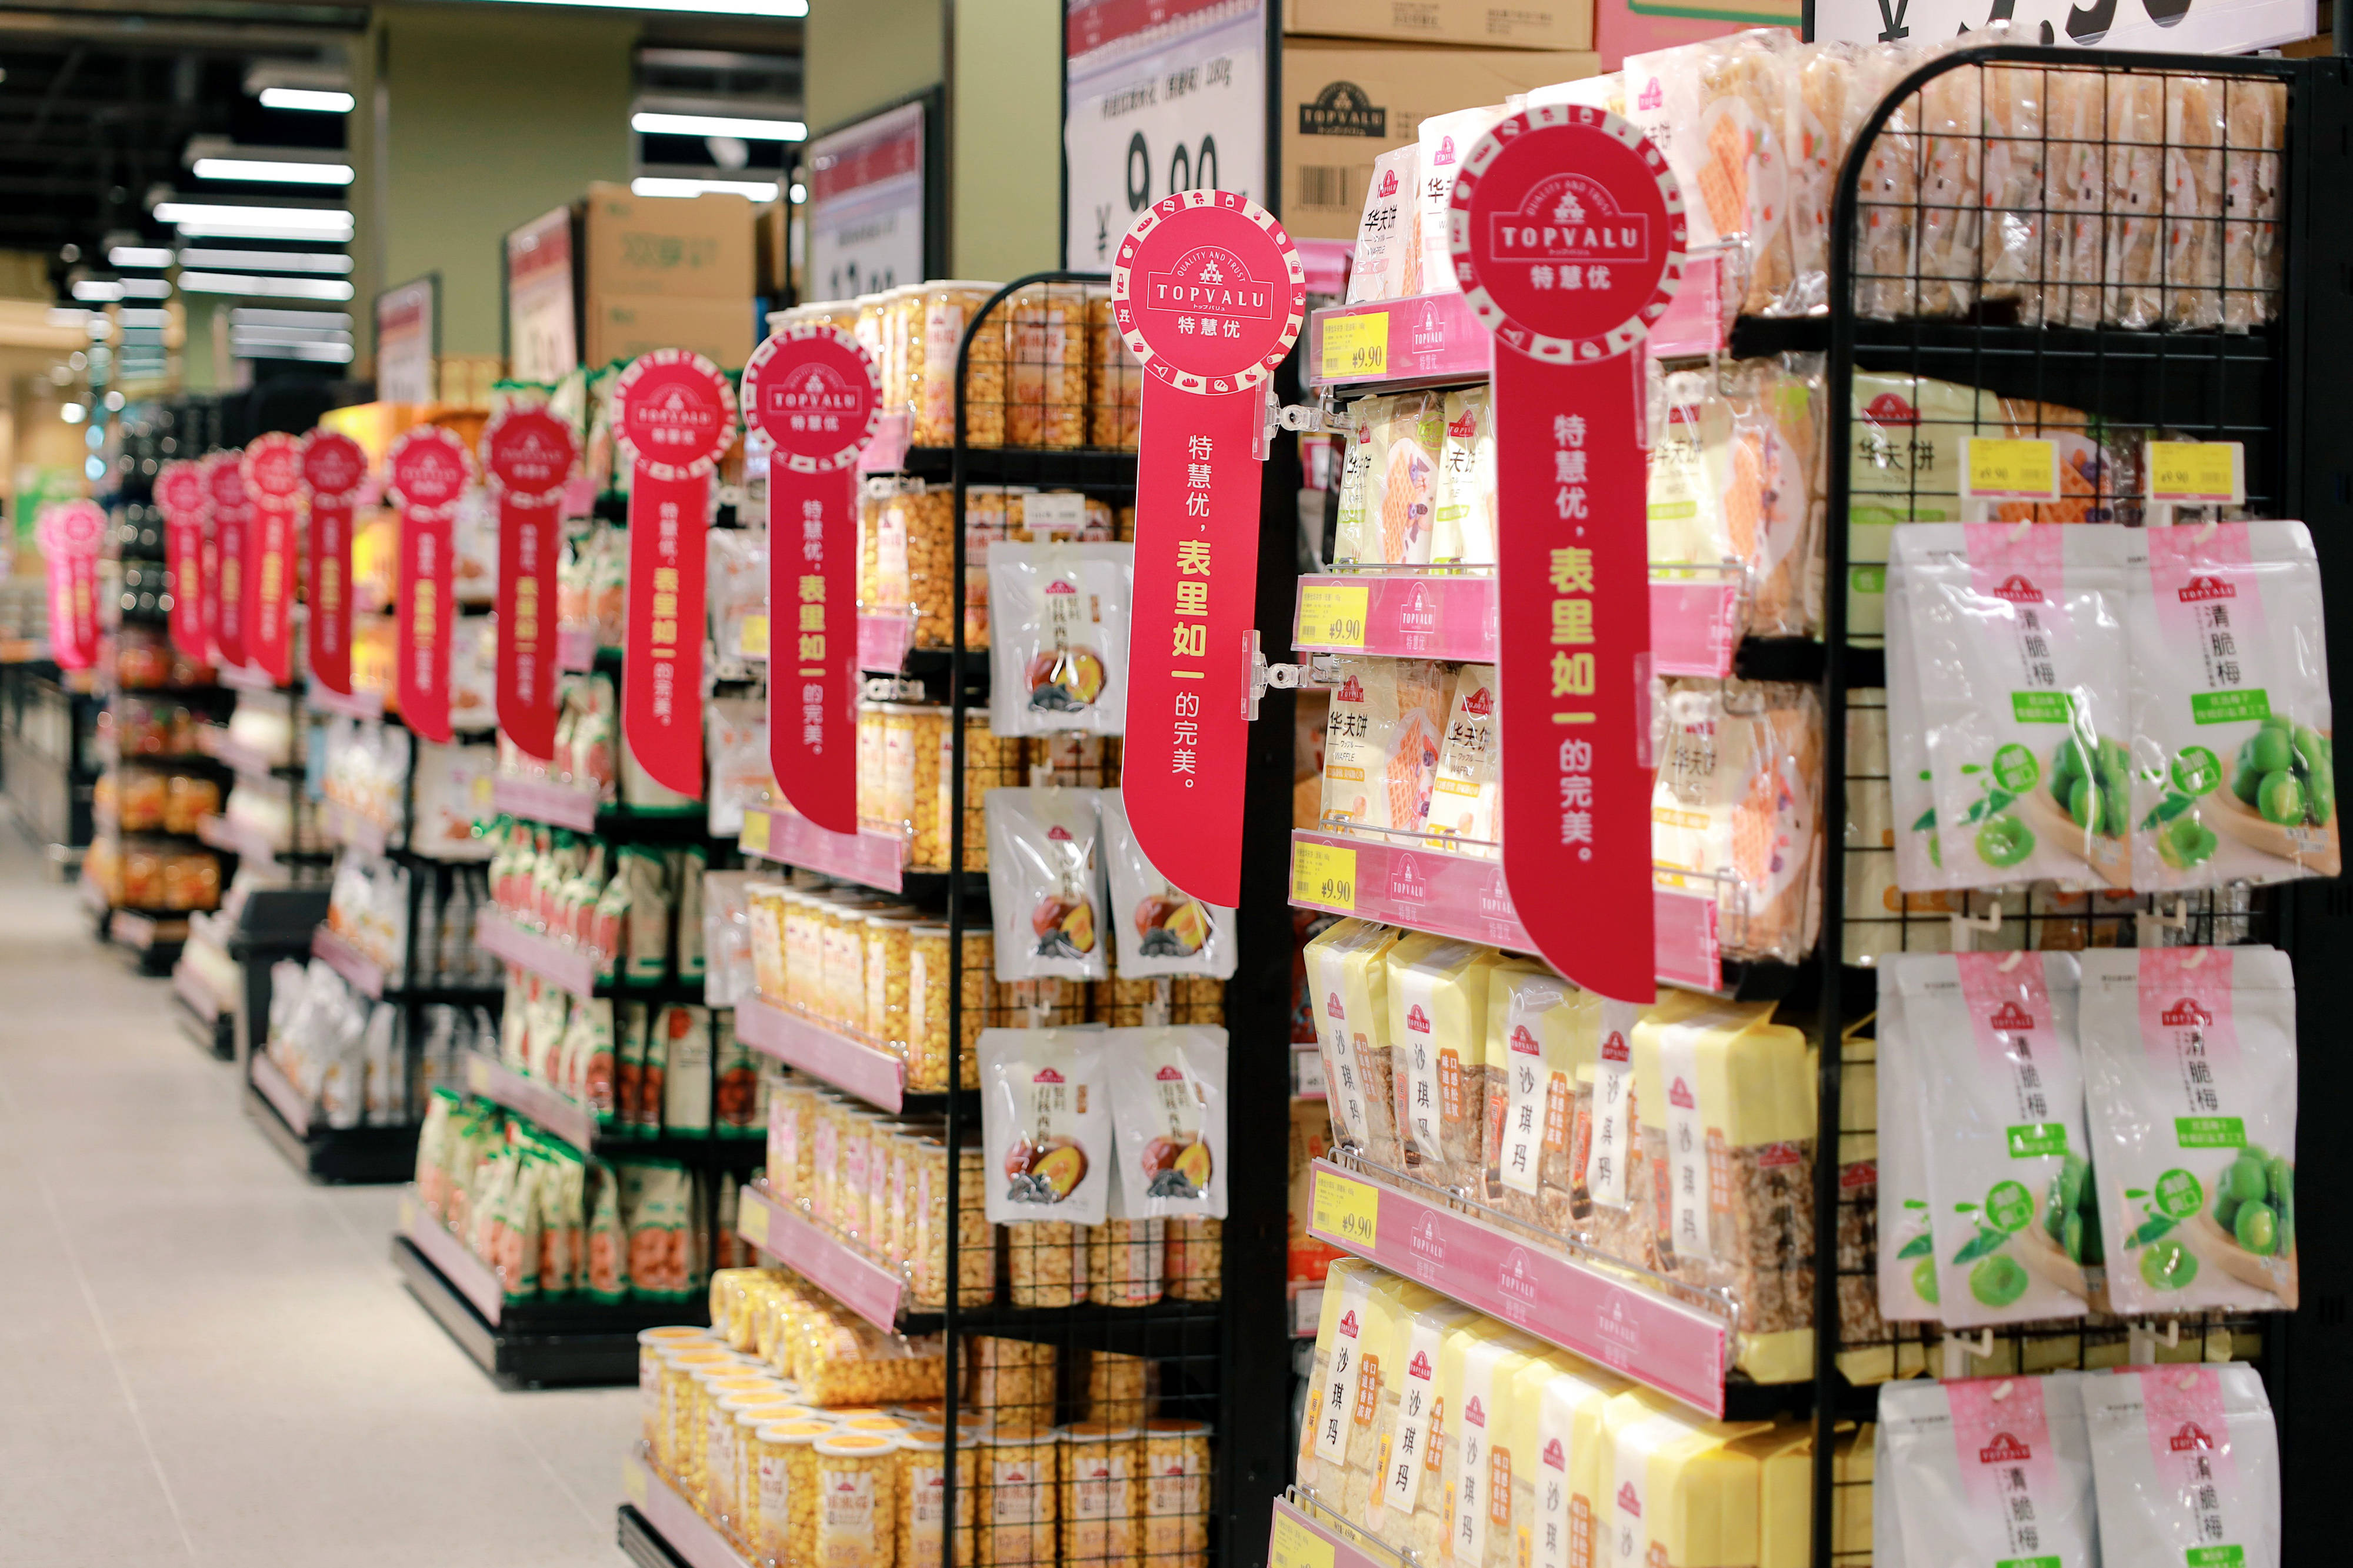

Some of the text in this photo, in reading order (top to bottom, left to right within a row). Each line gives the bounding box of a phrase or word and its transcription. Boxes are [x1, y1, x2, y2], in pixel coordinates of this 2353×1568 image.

[1365, 204, 1397, 232] 华夫饼
[1502, 226, 1638, 248] TOPVALU
[1177, 251, 1246, 282] QUALITY AND TRUST
[1531, 265, 1611, 289] 特慧优
[1156, 283, 1264, 308] TOPVALU
[1193, 303, 1225, 312] トップバリュ
[1178, 315, 1241, 339] 特慧优
[1415, 331, 1443, 345] TOPVALU
[1352, 345, 1382, 369] ¥9.90
[774, 392, 856, 408] TOPVALU
[1171, 434, 1213, 788] 特慧优，表里如一的完美。
[1403, 613, 1433, 625] TOPVALU
[1329, 619, 1360, 640] ¥9.90
[2205, 604, 2241, 685] 清脆梅
[1329, 710, 1368, 738] 华夫饼
[1340, 740, 1354, 749] ワッフル
[1448, 722, 1491, 752] 华夫饼
[1335, 752, 1355, 762] WAFFLE
[1322, 878, 1351, 902] ¥9.90
[1394, 882, 1424, 897] TOPVALU
[1408, 1019, 1429, 1030] TOPVALU
[1511, 1039, 1538, 1052] TOPVALU
[1335, 1029, 1361, 1125] 沙琪玛
[1450, 1057, 1459, 1117] 口感松软
[1414, 1043, 1429, 1138] 沙琪玛
[1512, 1065, 1535, 1173] 沙琪玛
[1342, 1213, 1372, 1239] ¥9.90
[1413, 1236, 1444, 1259] TOPVALU
[1501, 1273, 1535, 1299] TOPVALU
[1341, 1323, 1358, 1335] TOPVALU
[1411, 1364, 1431, 1378] TOPVALU
[1327, 1345, 1349, 1446] 沙琪玛
[1357, 1359, 1369, 1418] 味道香浓
[1365, 1363, 1377, 1421] 口感松软
[1395, 1389, 1422, 1493] 沙琪玛
[1462, 1435, 1478, 1545] 沙琪玛
[1545, 1480, 1559, 1568] 沙琪
